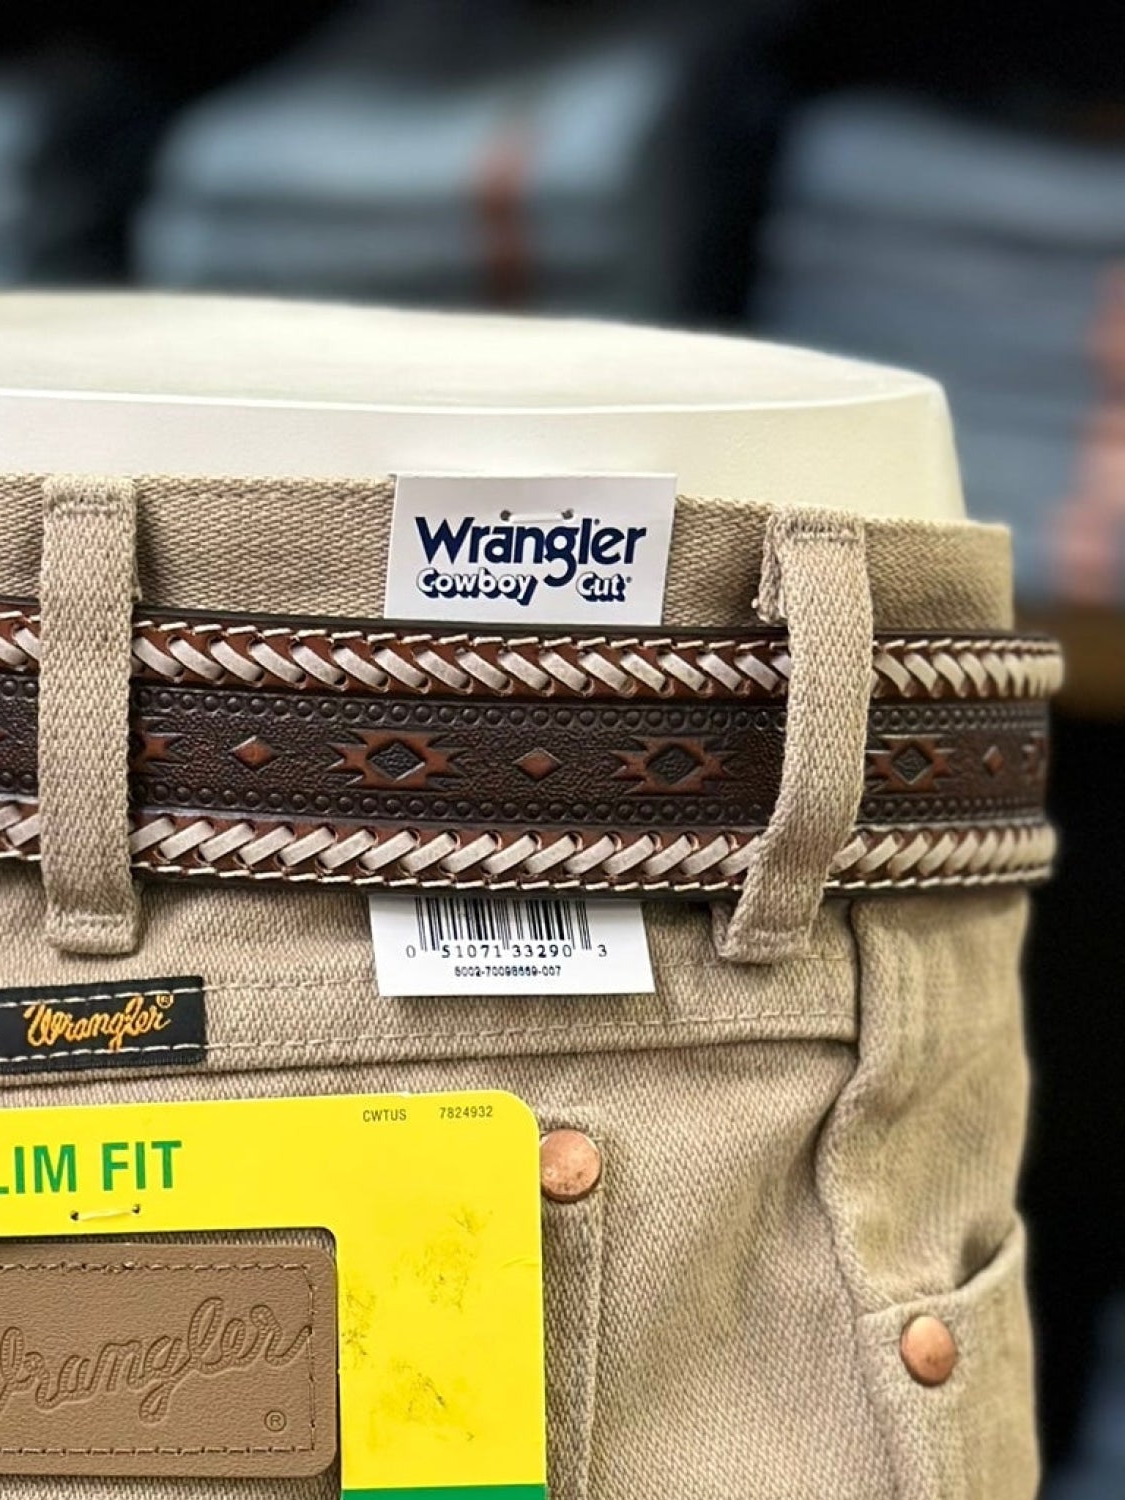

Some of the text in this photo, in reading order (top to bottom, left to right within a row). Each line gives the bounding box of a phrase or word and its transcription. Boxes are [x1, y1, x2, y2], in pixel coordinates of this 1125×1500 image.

[415, 516, 647, 587] Wrangler
[416, 567, 626, 606] Cowboy Cut
[441, 944, 502, 959] 51071
[512, 944, 573, 959] 33290
[23, 995, 172, 1054] Wrangler
[362, 1105, 493, 1122] CWTUS 7824932
[101, 1140, 183, 1191] FIT
